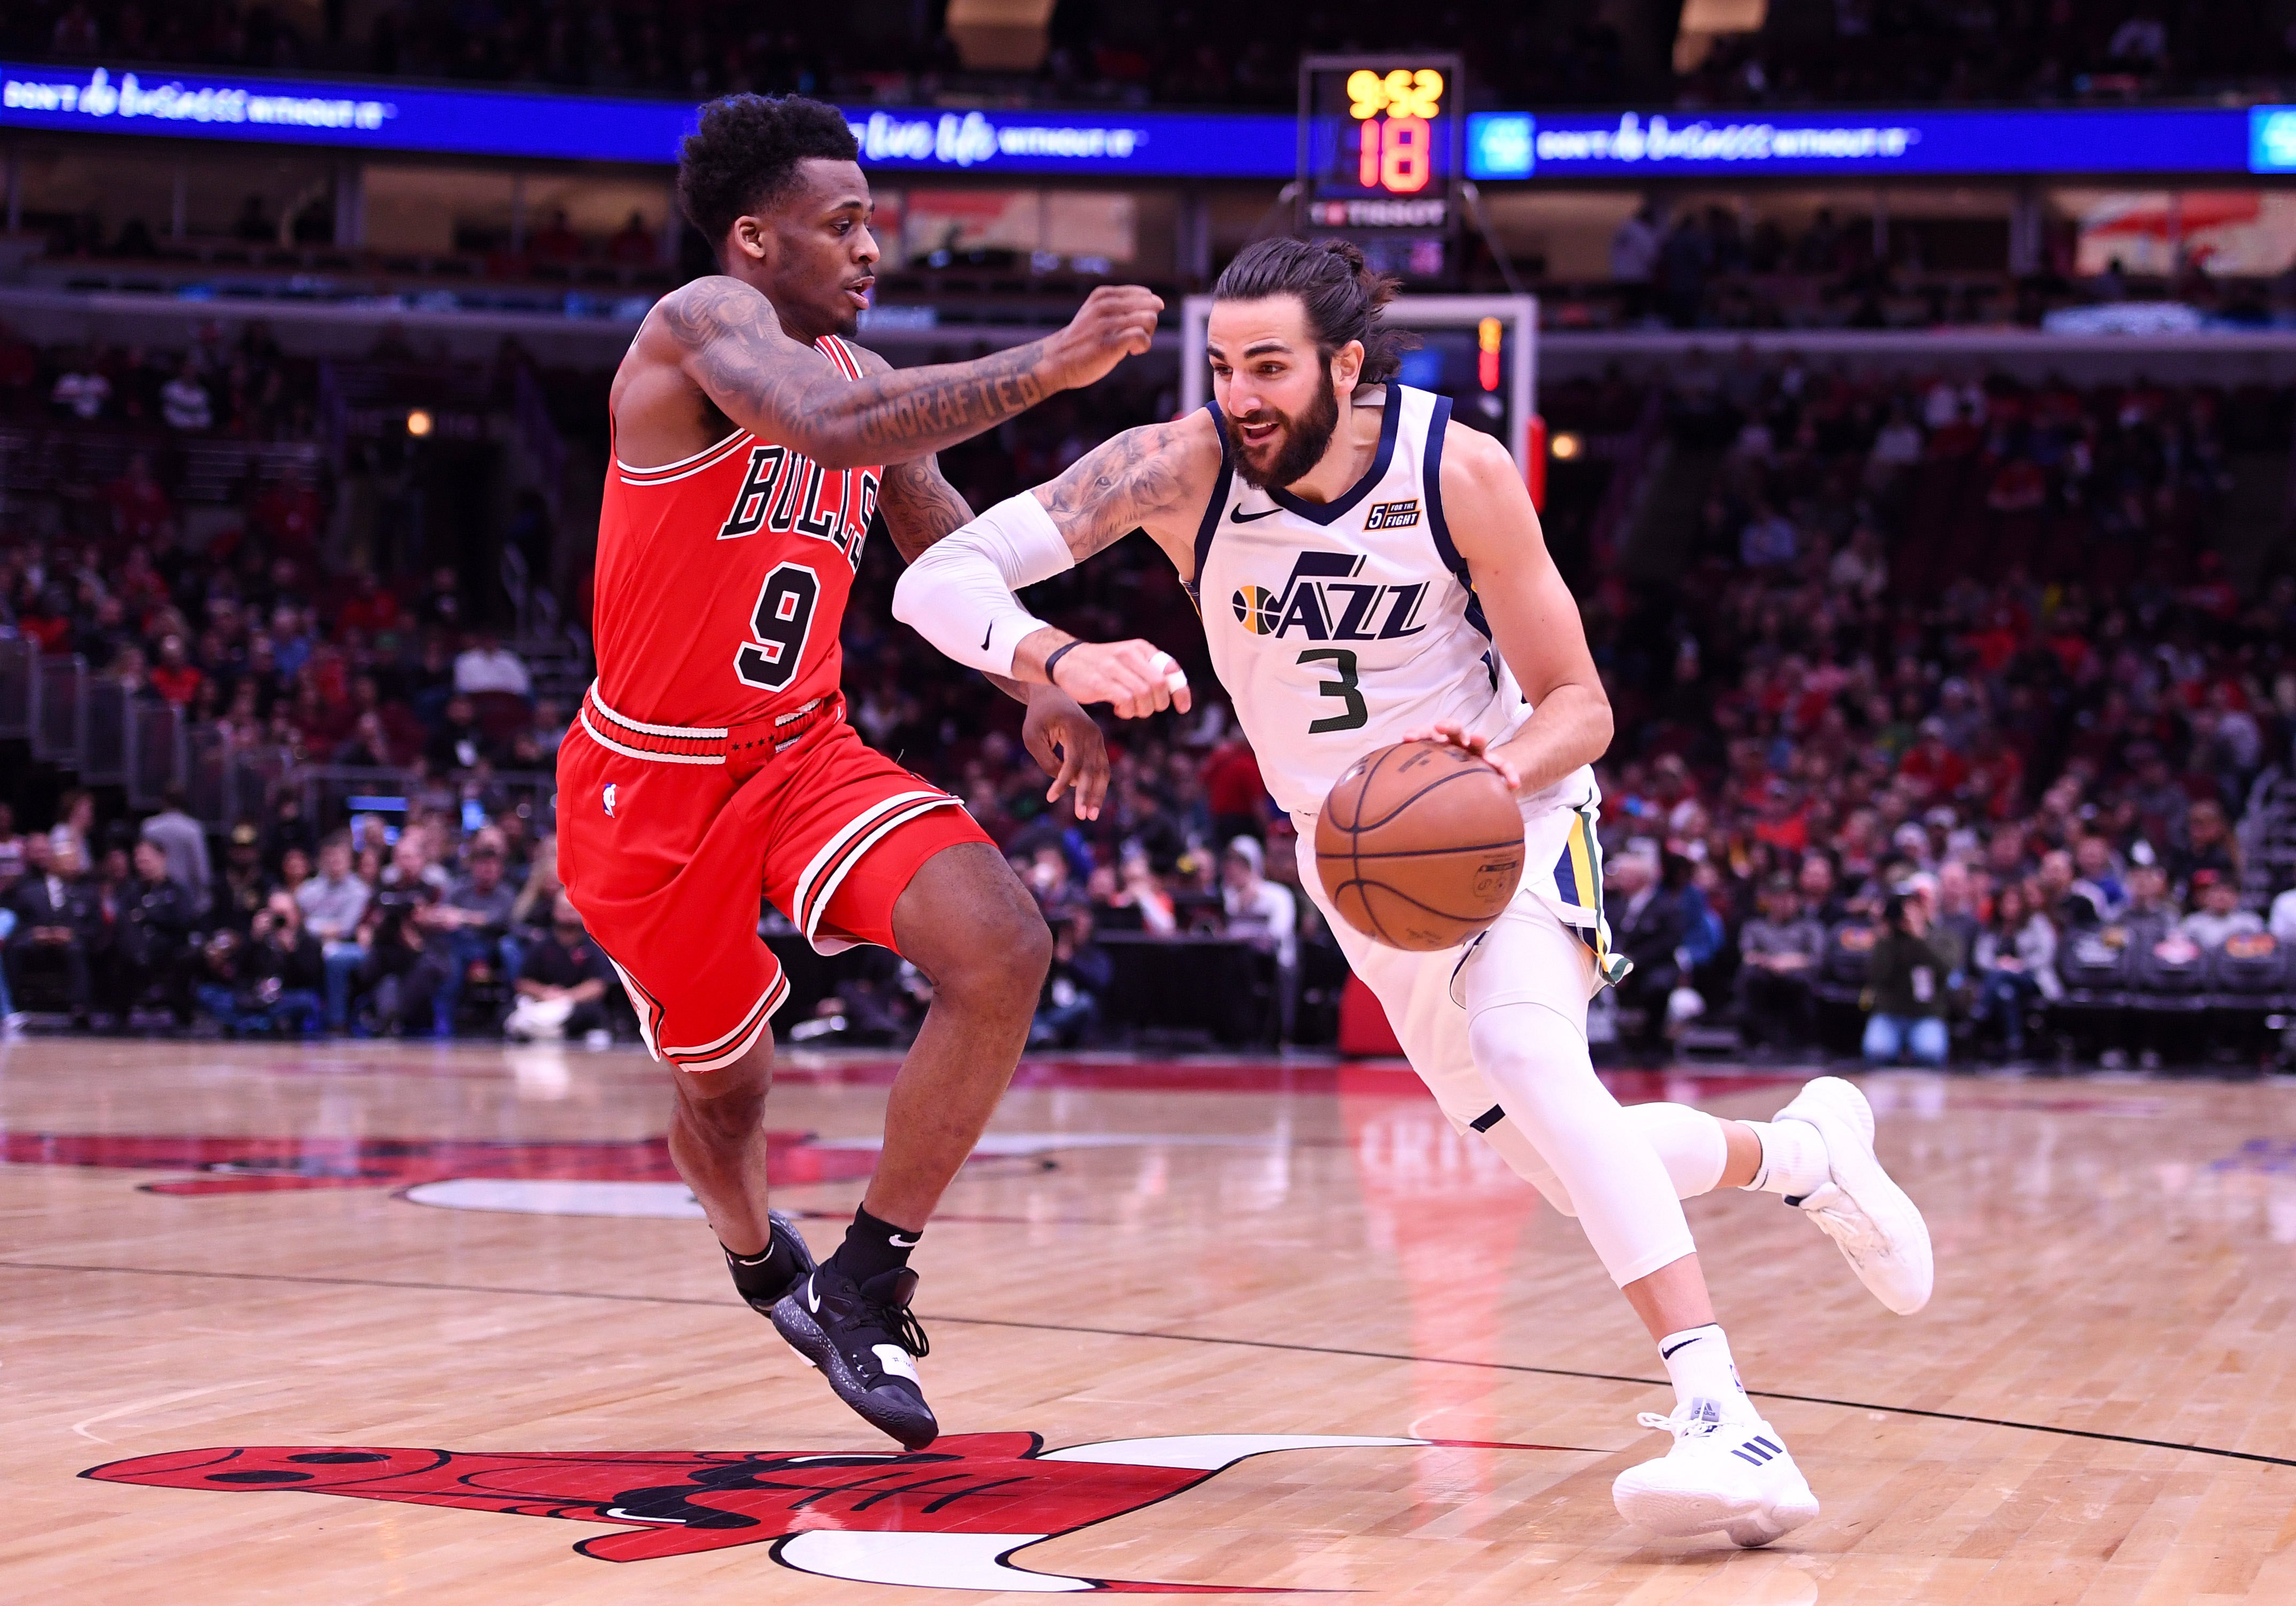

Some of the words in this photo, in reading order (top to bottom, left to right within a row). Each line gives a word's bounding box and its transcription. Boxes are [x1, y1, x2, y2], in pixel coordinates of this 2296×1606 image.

[1347, 69, 1443, 119] 9:52
[1360, 115, 1430, 192] 18
[716, 445, 880, 575] BULLS
[1369, 506, 1385, 528] 5
[1385, 513, 1417, 527] FIGHT
[1403, 502, 1414, 510] THE
[733, 561, 821, 693] 9
[1232, 551, 1431, 641] JAZZ
[1296, 648, 1368, 734] 3
